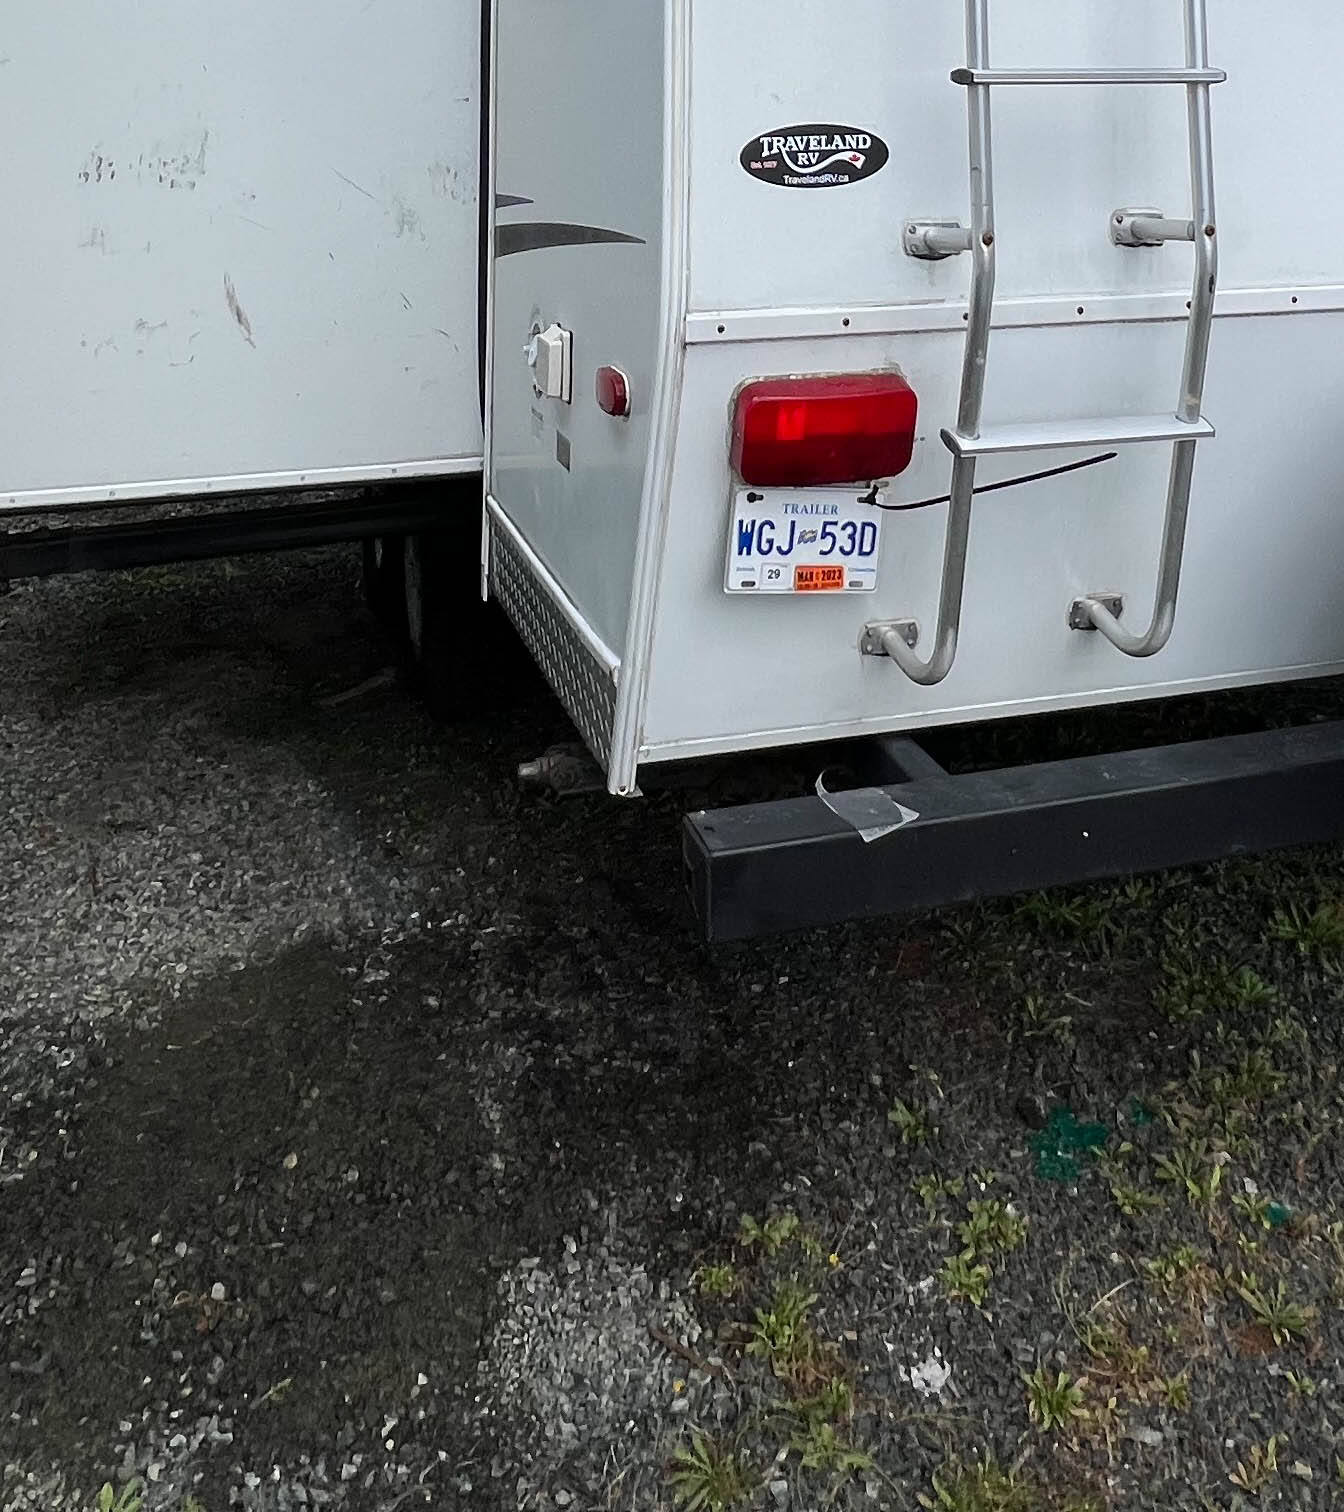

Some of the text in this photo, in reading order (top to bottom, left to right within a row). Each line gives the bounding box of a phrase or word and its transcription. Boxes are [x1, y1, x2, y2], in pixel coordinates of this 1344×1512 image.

[759, 134, 872, 157] TRAVELAND
[797, 152, 820, 166] RV
[782, 503, 840, 516] TRAILER
[737, 519, 878, 557] WGJ 53D
[767, 569, 781, 580] 29
[821, 569, 842, 581] 2023
